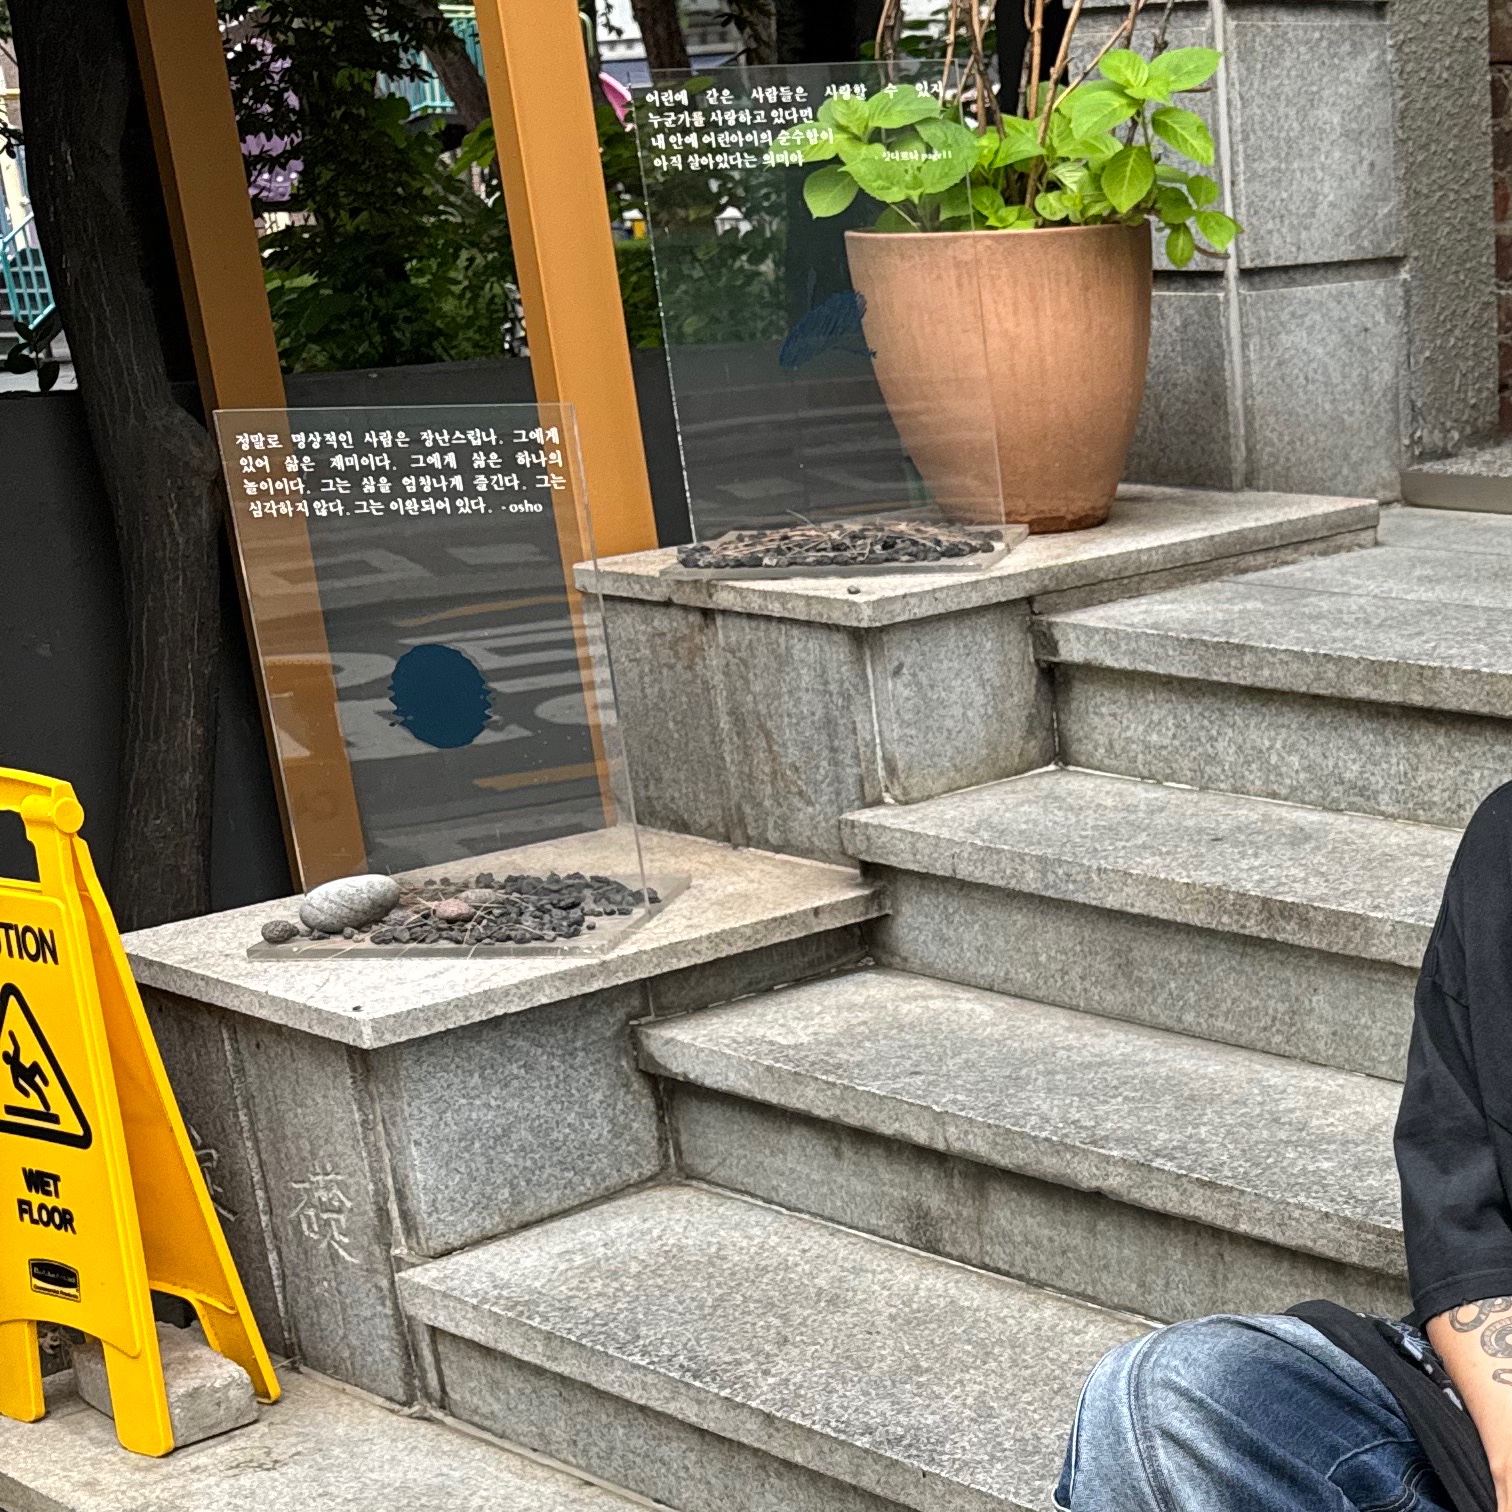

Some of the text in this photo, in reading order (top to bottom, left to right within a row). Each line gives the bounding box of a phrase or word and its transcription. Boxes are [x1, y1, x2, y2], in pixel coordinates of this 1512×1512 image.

[705, 88, 734, 105] 같은
[751, 86, 808, 103] 사람들은
[884, 83, 898, 99] 수
[648, 107, 813, 129] 누군가를 사랑하고 있다면
[651, 132, 665, 150] 내
[669, 133, 699, 150] 안에
[702, 130, 773, 148] 어린아이의
[654, 154, 683, 171] 아직
[687, 152, 757, 170] 살아있다는
[236, 432, 283, 450] 정말로
[291, 431, 354, 450] 명상적인
[364, 430, 410, 448] 사람은
[513, 426, 559, 445] 그에게
[240, 450, 562, 473] 있어 삶은 재미이다. 그에게 삶은 하나의
[243, 473, 566, 495] 놀이이다. 그는 삶을 엄청나게 즐긴다. 그는
[249, 500, 309, 518] 심각하지
[313, 499, 350, 517] 않다.
[354, 500, 385, 516] 그는
[390, 497, 451, 516] 이완되어
[456, 496, 492, 514] 있다.
[0, 921, 59, 966] TION
[21, 1166, 61, 1199] WET
[16, 1197, 77, 1235] FLOOR
